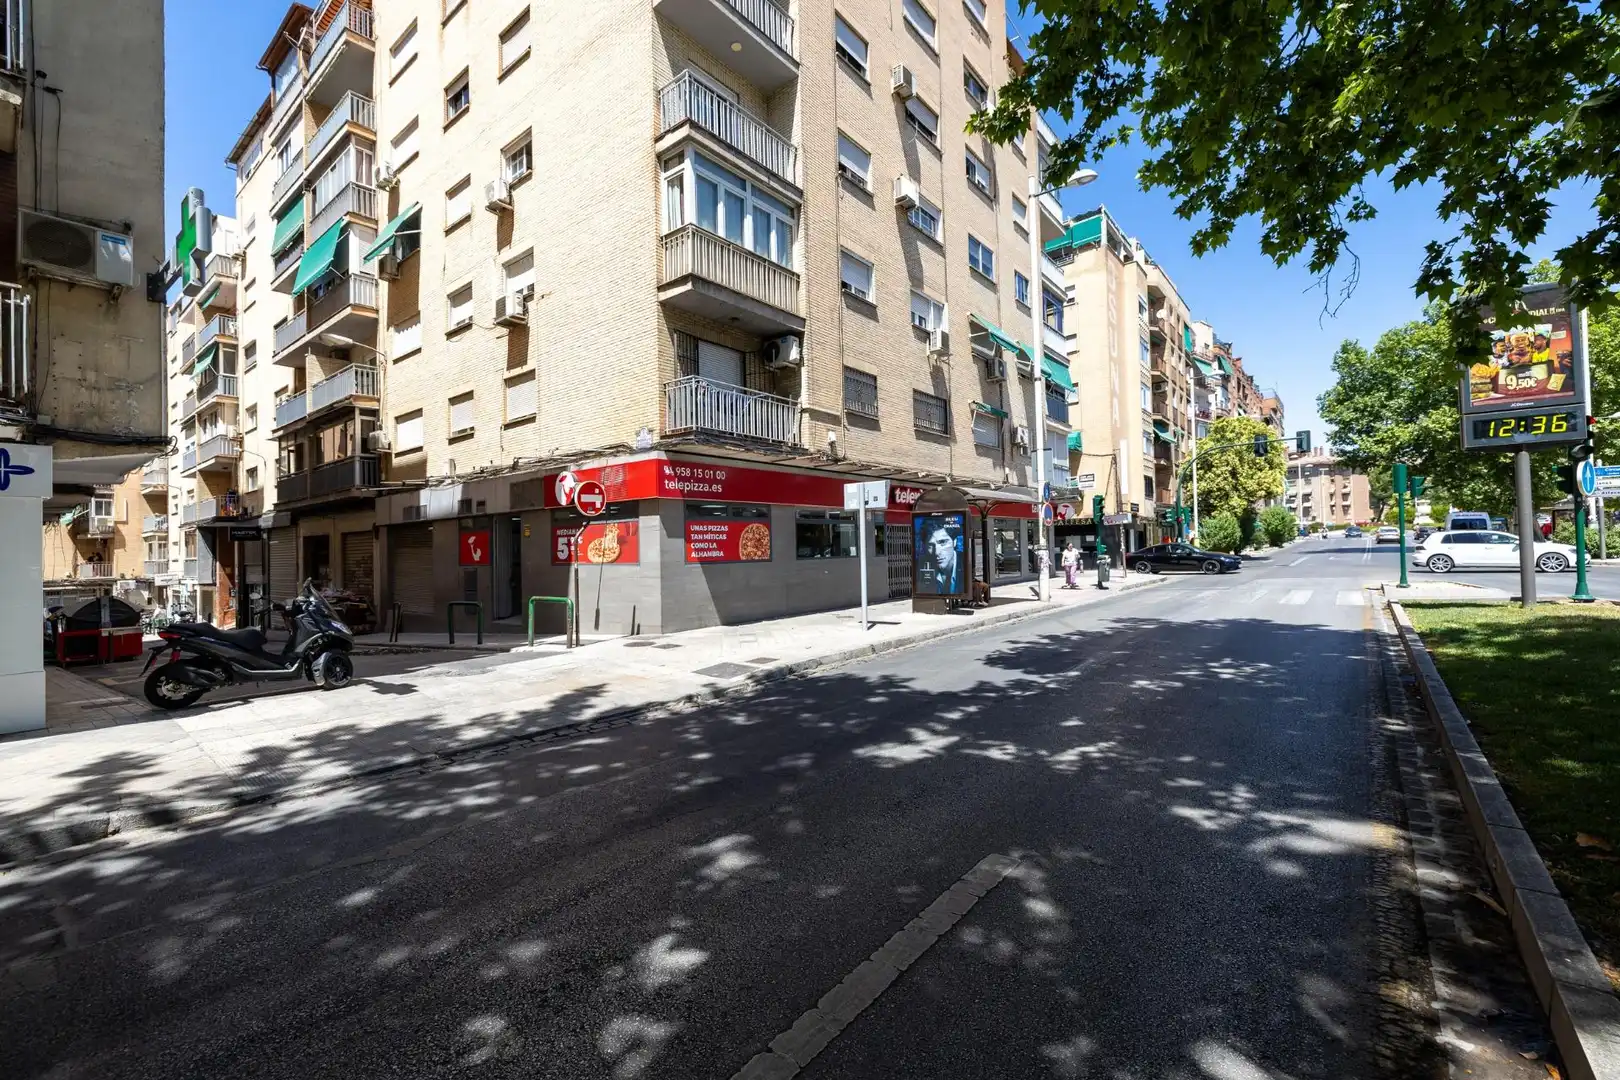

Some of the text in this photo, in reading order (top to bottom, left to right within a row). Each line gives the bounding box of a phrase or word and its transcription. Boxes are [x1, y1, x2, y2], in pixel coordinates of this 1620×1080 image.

[1506, 374, 1537, 390] 9,50€
[1489, 414, 1567, 437] 12:36
[675, 466, 726, 480] 958 15 01 00
[664, 477, 723, 494] telepizza.es
[703, 532, 727, 540] MÍTICAS
[691, 550, 724, 558] ALHAMBRA
